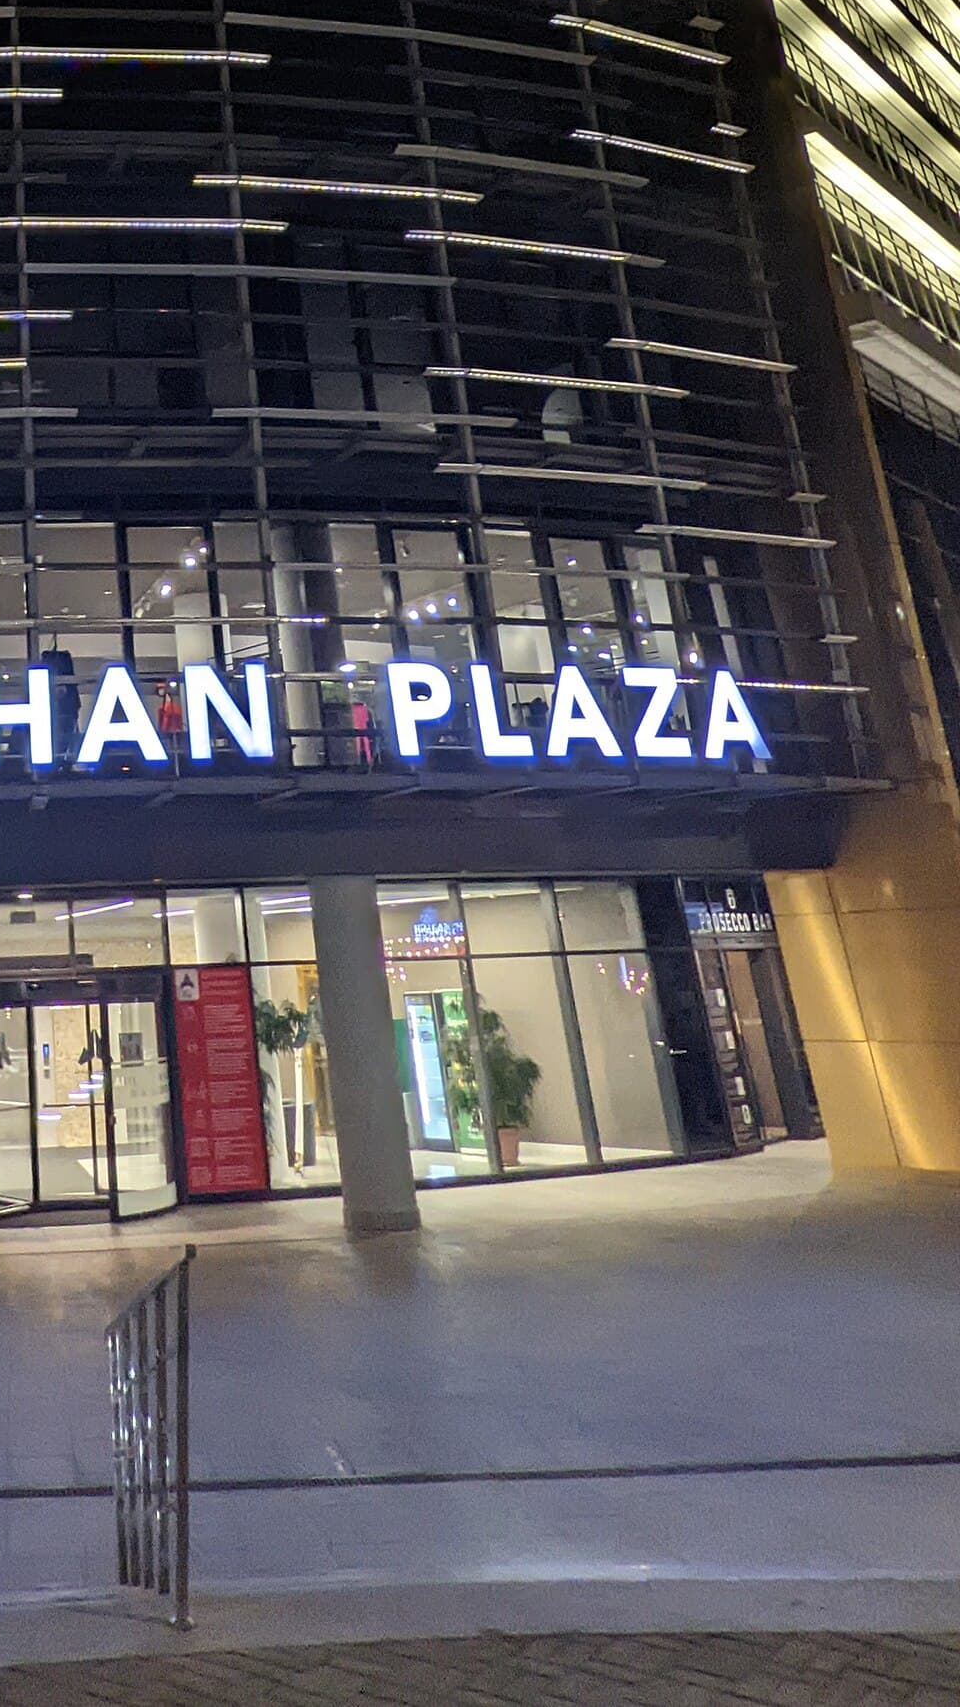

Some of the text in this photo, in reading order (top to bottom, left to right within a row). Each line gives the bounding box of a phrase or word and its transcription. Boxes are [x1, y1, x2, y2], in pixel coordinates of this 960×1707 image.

[386, 662, 773, 759] PLAZA
[698, 912, 774, 932] PROSECCO BAR
